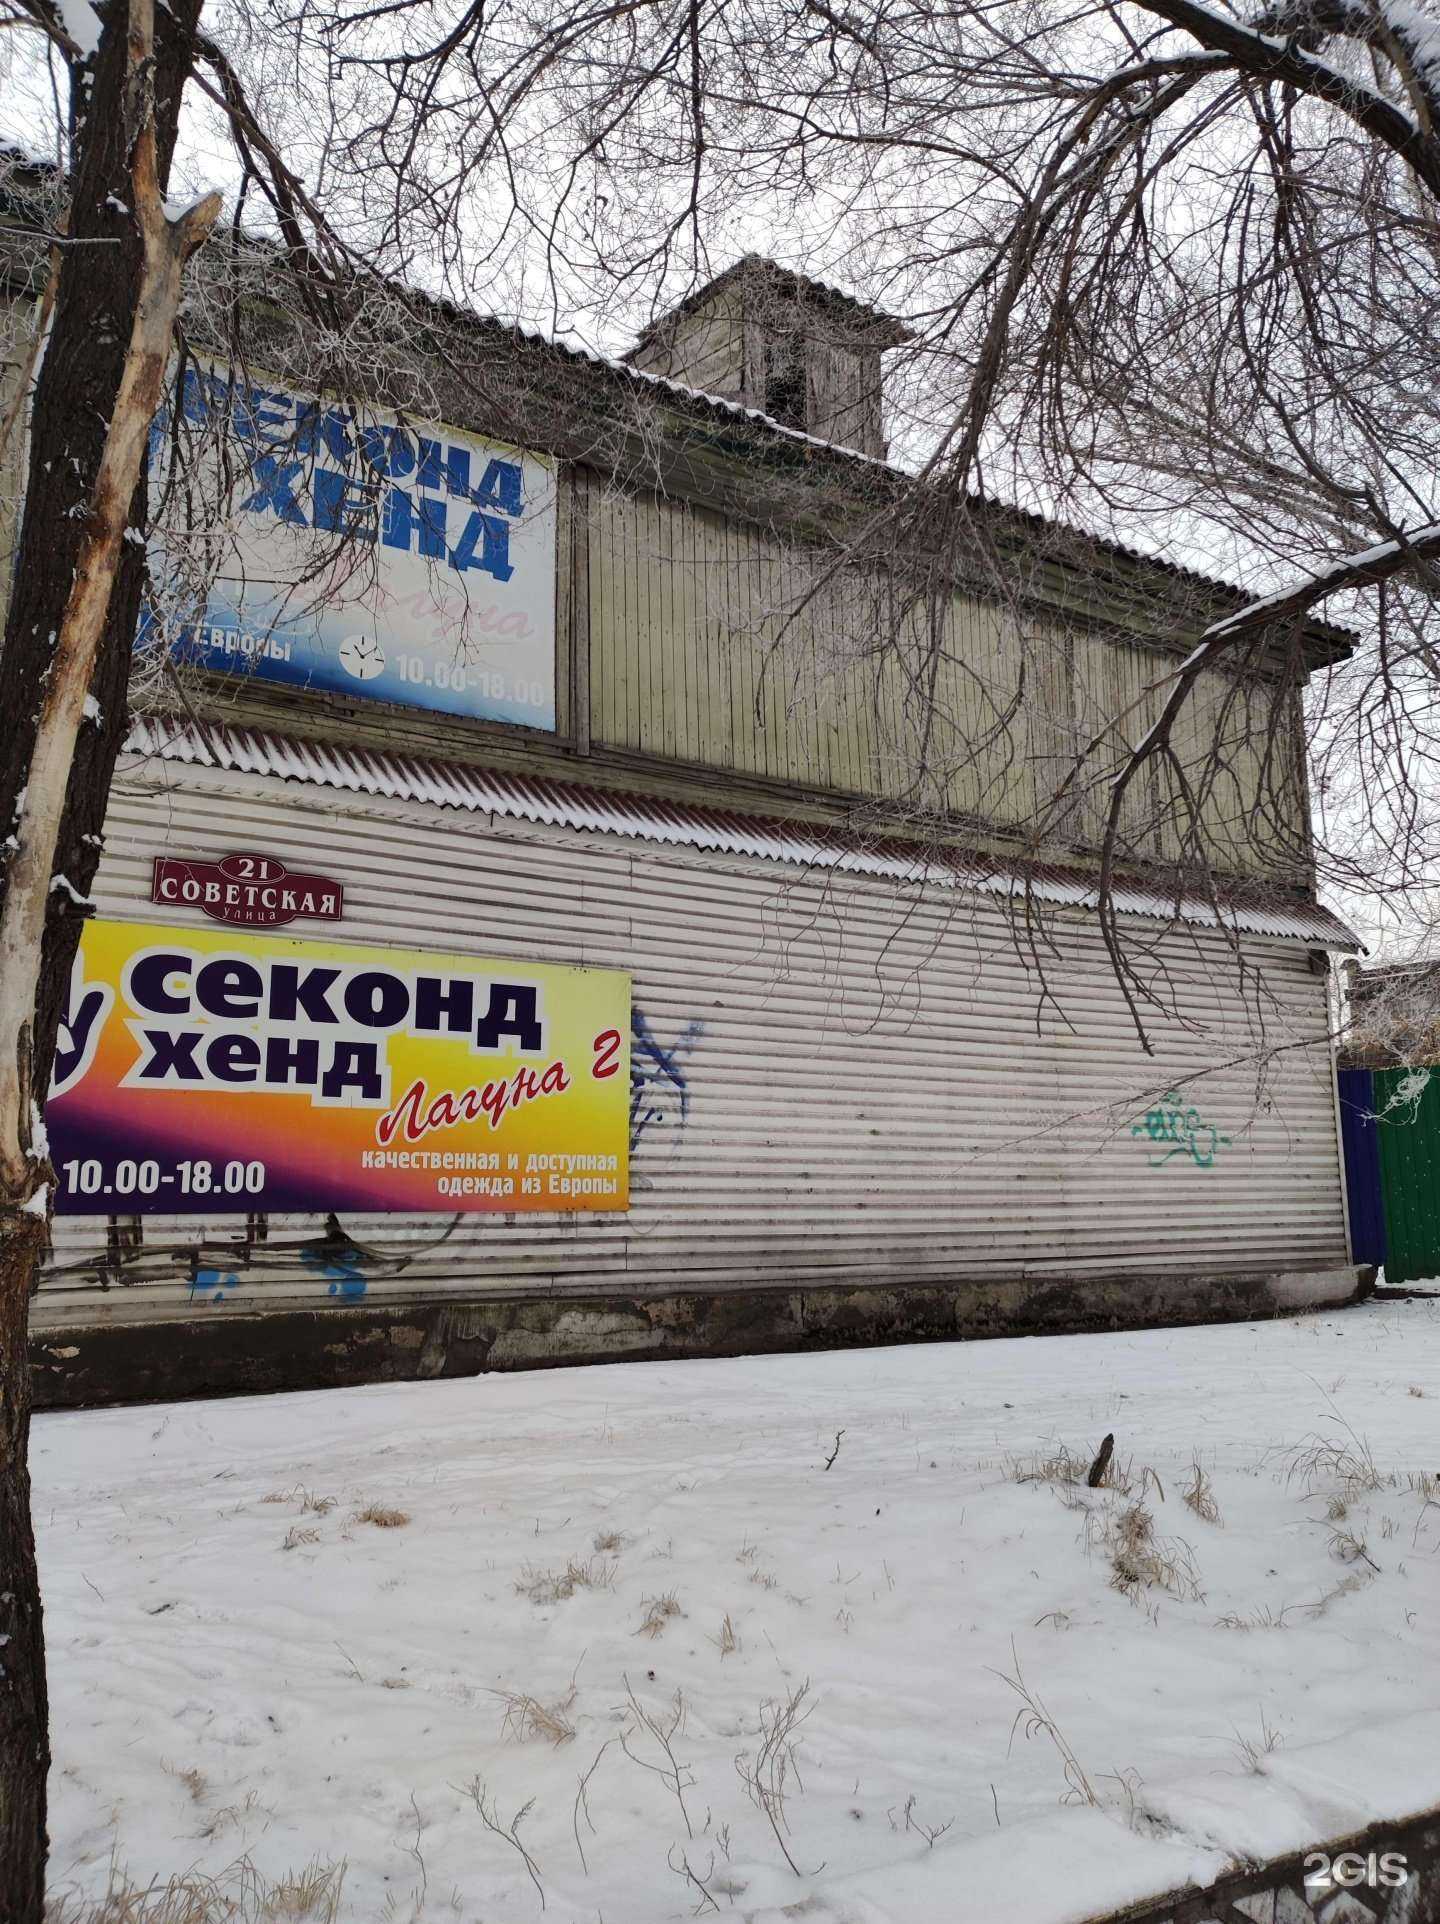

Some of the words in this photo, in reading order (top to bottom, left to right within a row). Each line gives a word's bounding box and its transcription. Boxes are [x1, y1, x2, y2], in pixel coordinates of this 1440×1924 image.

[239, 447, 514, 582] ХЕНД
[396, 654, 545, 707] 10.00-18.00
[238, 858, 269, 880] 21
[161, 877, 336, 914] СОВЕТСКАЯ
[223, 906, 276, 922] улица
[131, 954, 542, 1051] секонд
[139, 1030, 382, 1099] хенд
[379, 1062, 571, 1142] Лагуна
[592, 1029, 621, 1079] 2
[63, 1159, 266, 1194] 10.00-18.00
[361, 1150, 500, 1169] качественная
[507, 1152, 519, 1169] и
[525, 1152, 618, 1174] доступная
[437, 1175, 514, 1197] одежда
[521, 1177, 542, 1195] из
[549, 1173, 617, 1197] Европы
